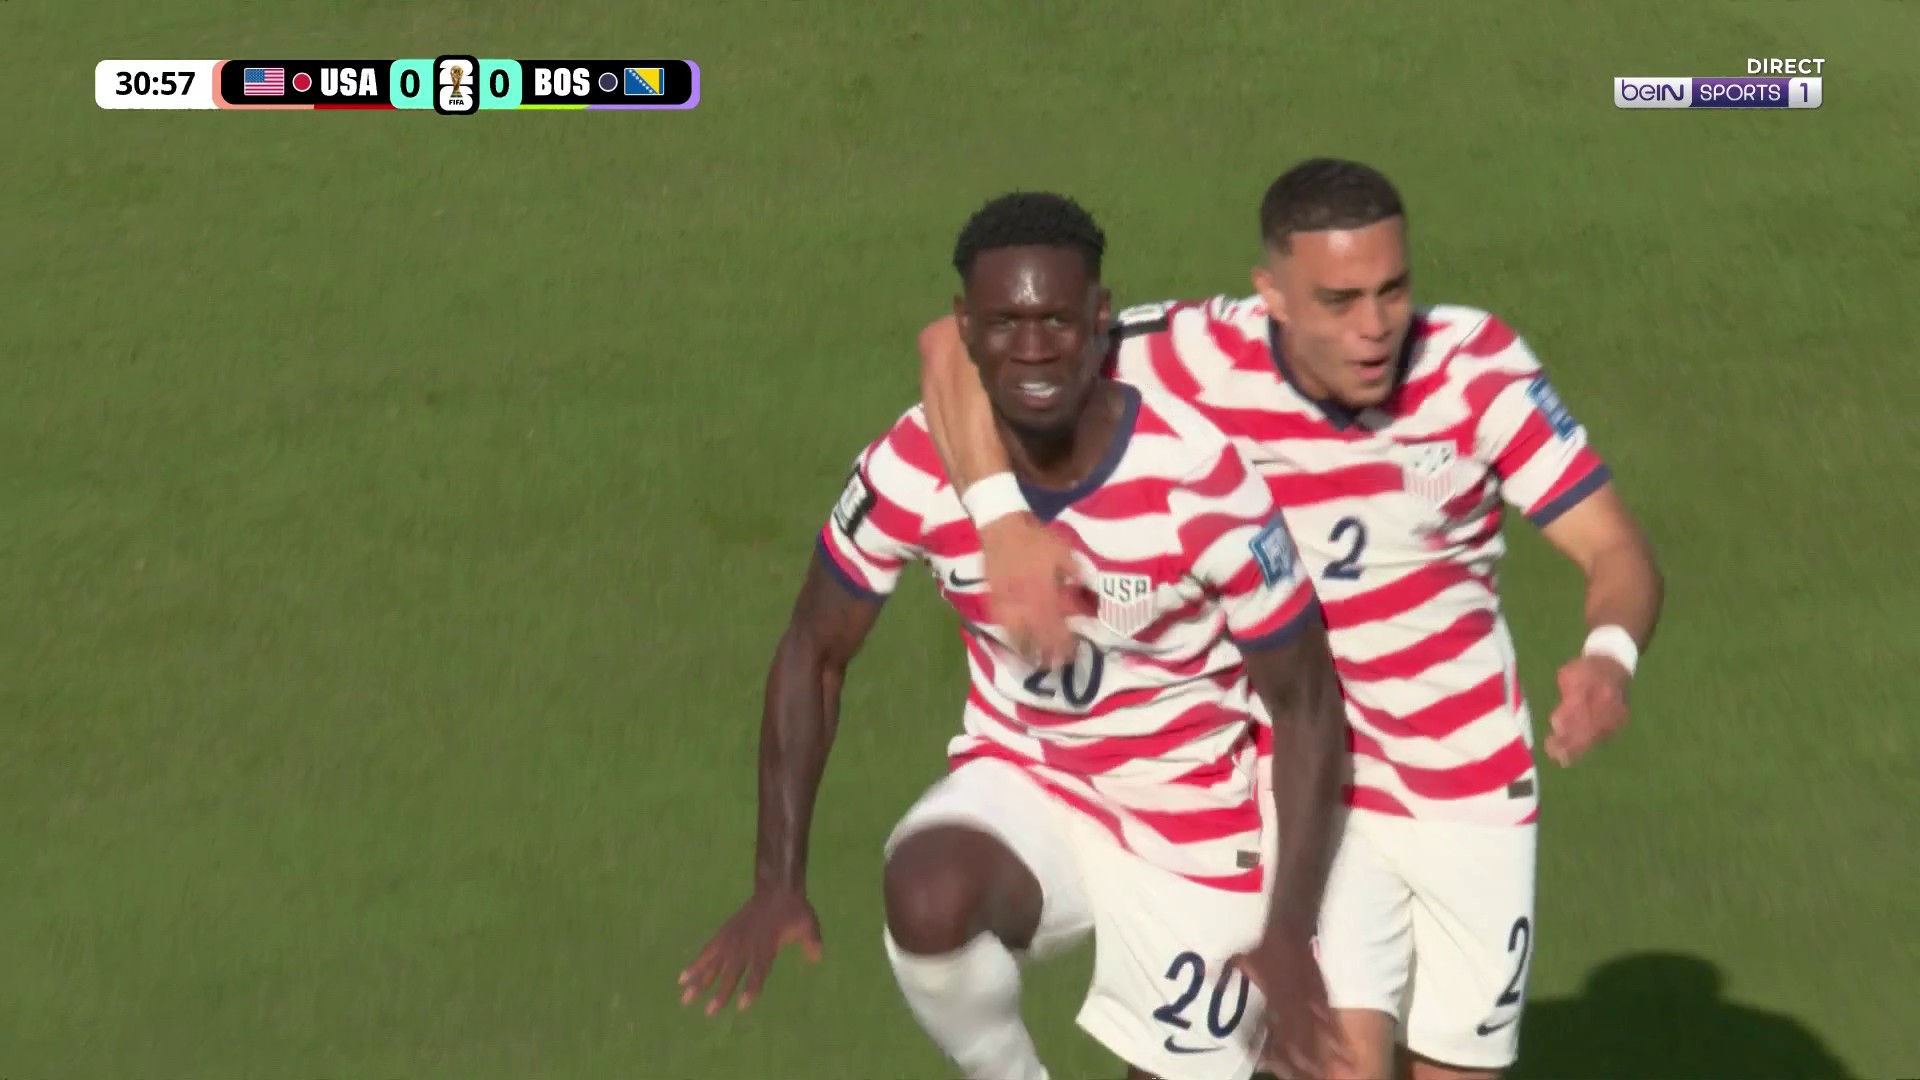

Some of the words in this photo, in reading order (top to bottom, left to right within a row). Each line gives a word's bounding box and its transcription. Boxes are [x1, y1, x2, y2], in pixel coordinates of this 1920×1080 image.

[1322, 516, 1369, 581] 2
[1103, 577, 1148, 603] USA
[1153, 951, 1250, 1038] 20
[1496, 916, 1530, 1008] 2
